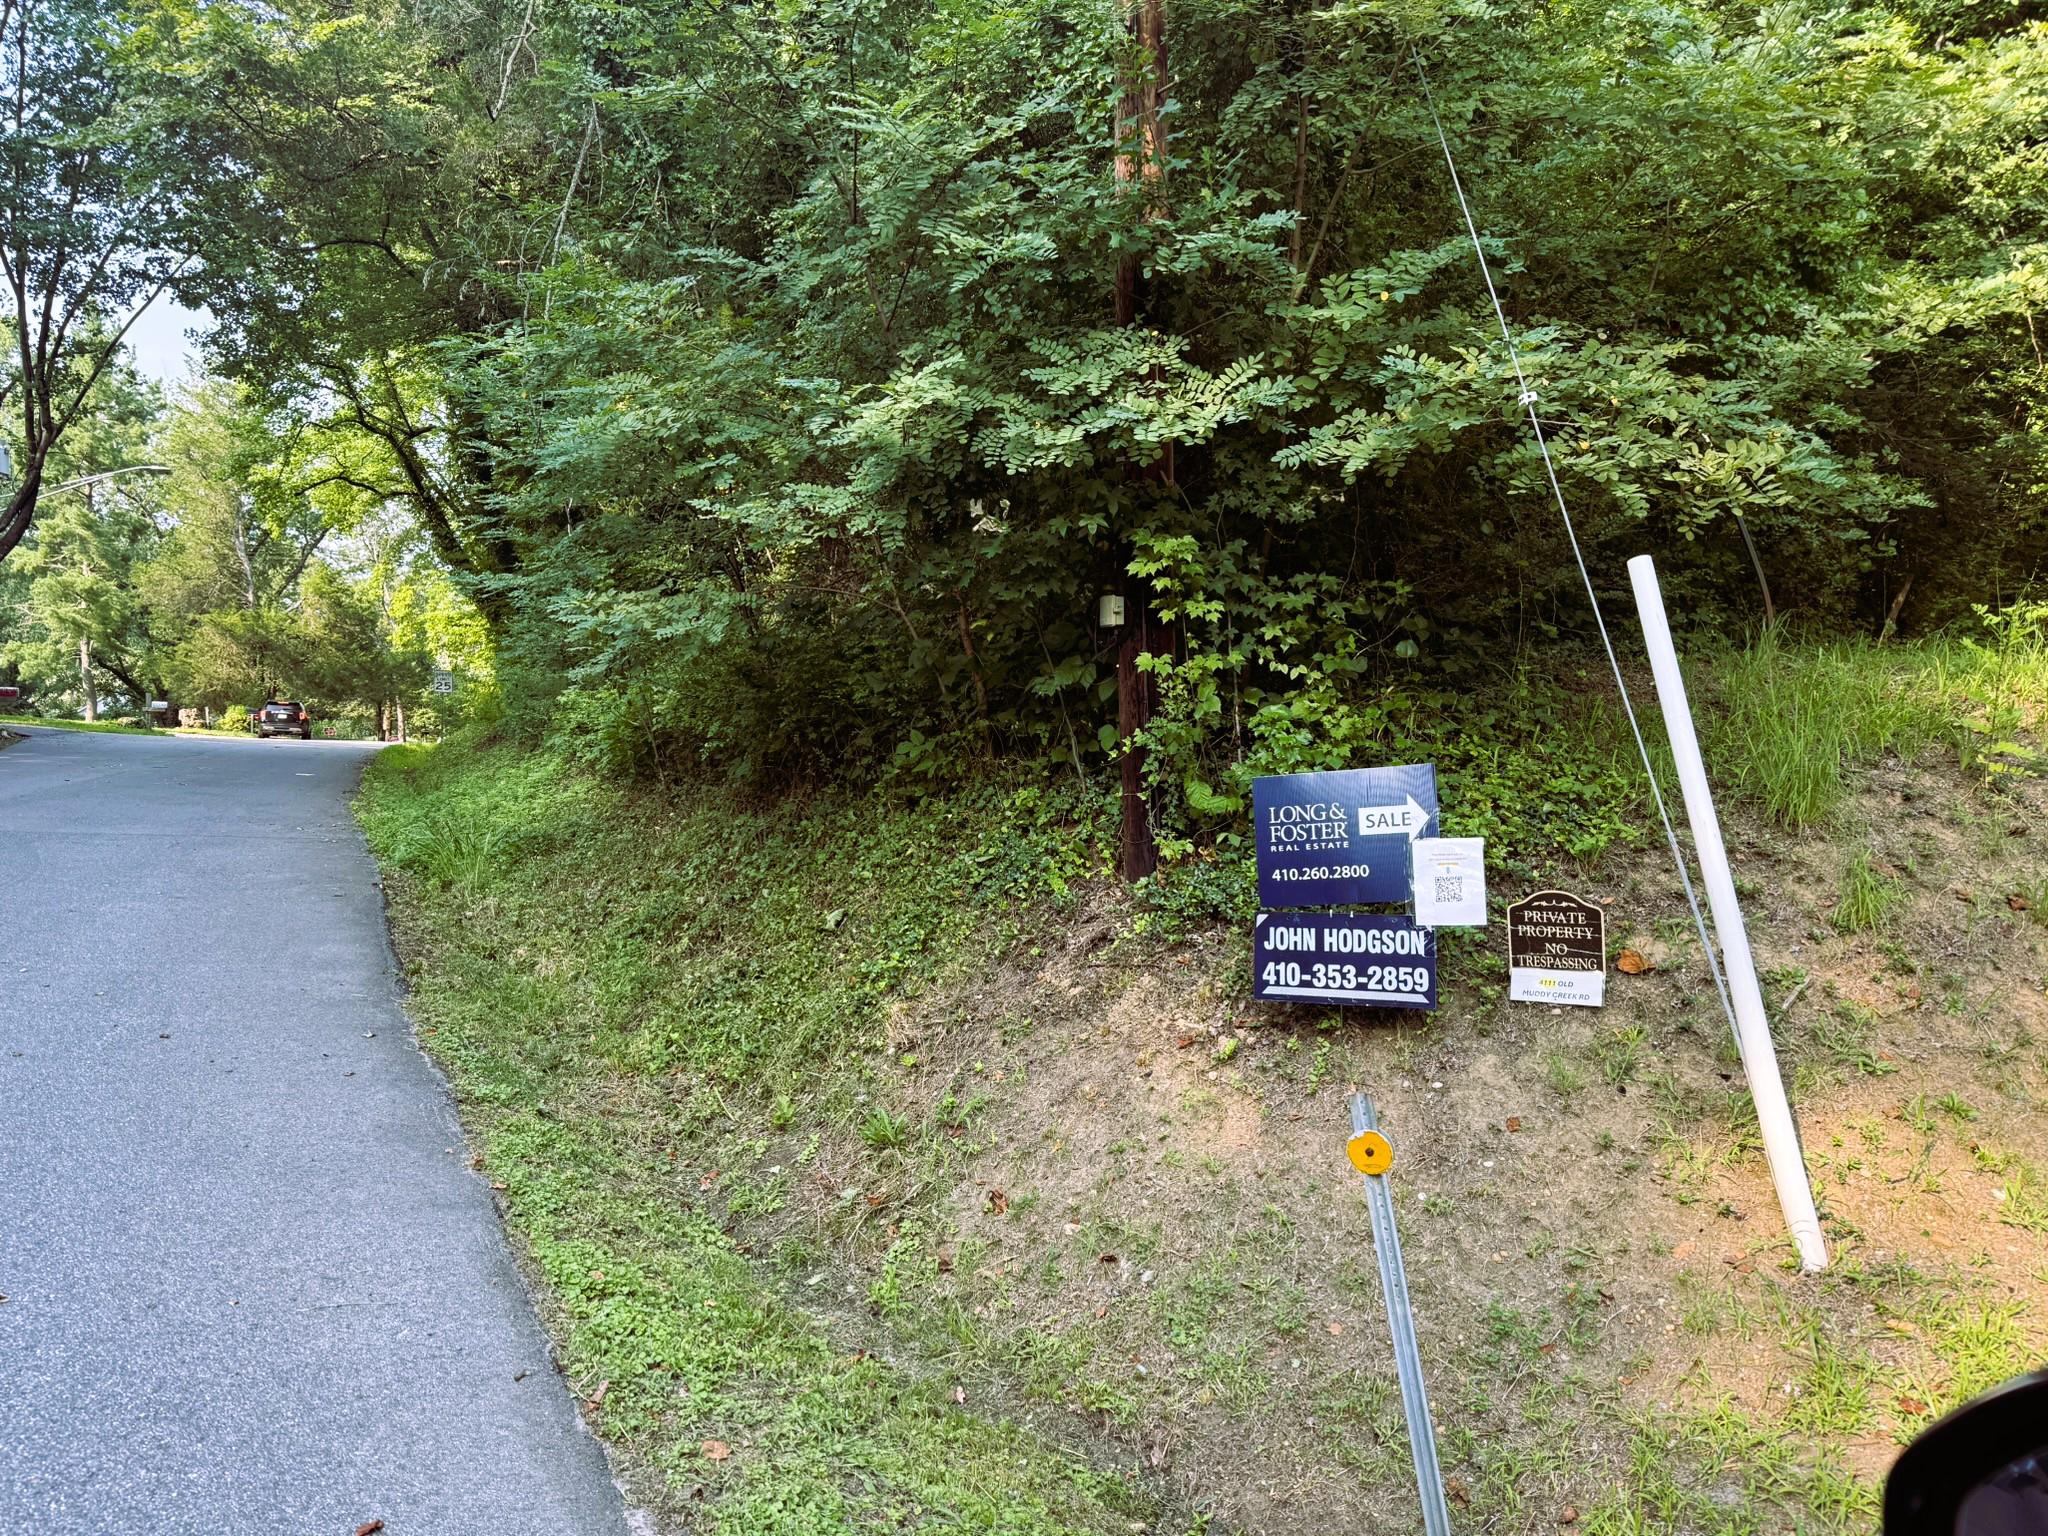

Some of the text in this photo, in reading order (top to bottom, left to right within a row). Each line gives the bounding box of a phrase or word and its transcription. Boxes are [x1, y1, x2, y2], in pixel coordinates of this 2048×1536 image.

[436, 681, 451, 690] 25
[1268, 802, 1348, 824] LONG &
[1365, 811, 1412, 829] SALE
[1269, 821, 1349, 843] FOSTER
[1270, 841, 1350, 853] REAL ESTATE
[1271, 864, 1370, 882] 410.260.2800
[1524, 910, 1587, 924] PRIVATE
[1518, 925, 1594, 939] PROPERTY
[1263, 926, 1425, 956] JOHN HODGSON
[1545, 942, 1568, 955] NO
[1517, 954, 1598, 970] TRESPASSING
[1262, 961, 1429, 992] 410-353-2859
[1557, 980, 1574, 988] OLD
[1578, 993, 1590, 1001] RD
